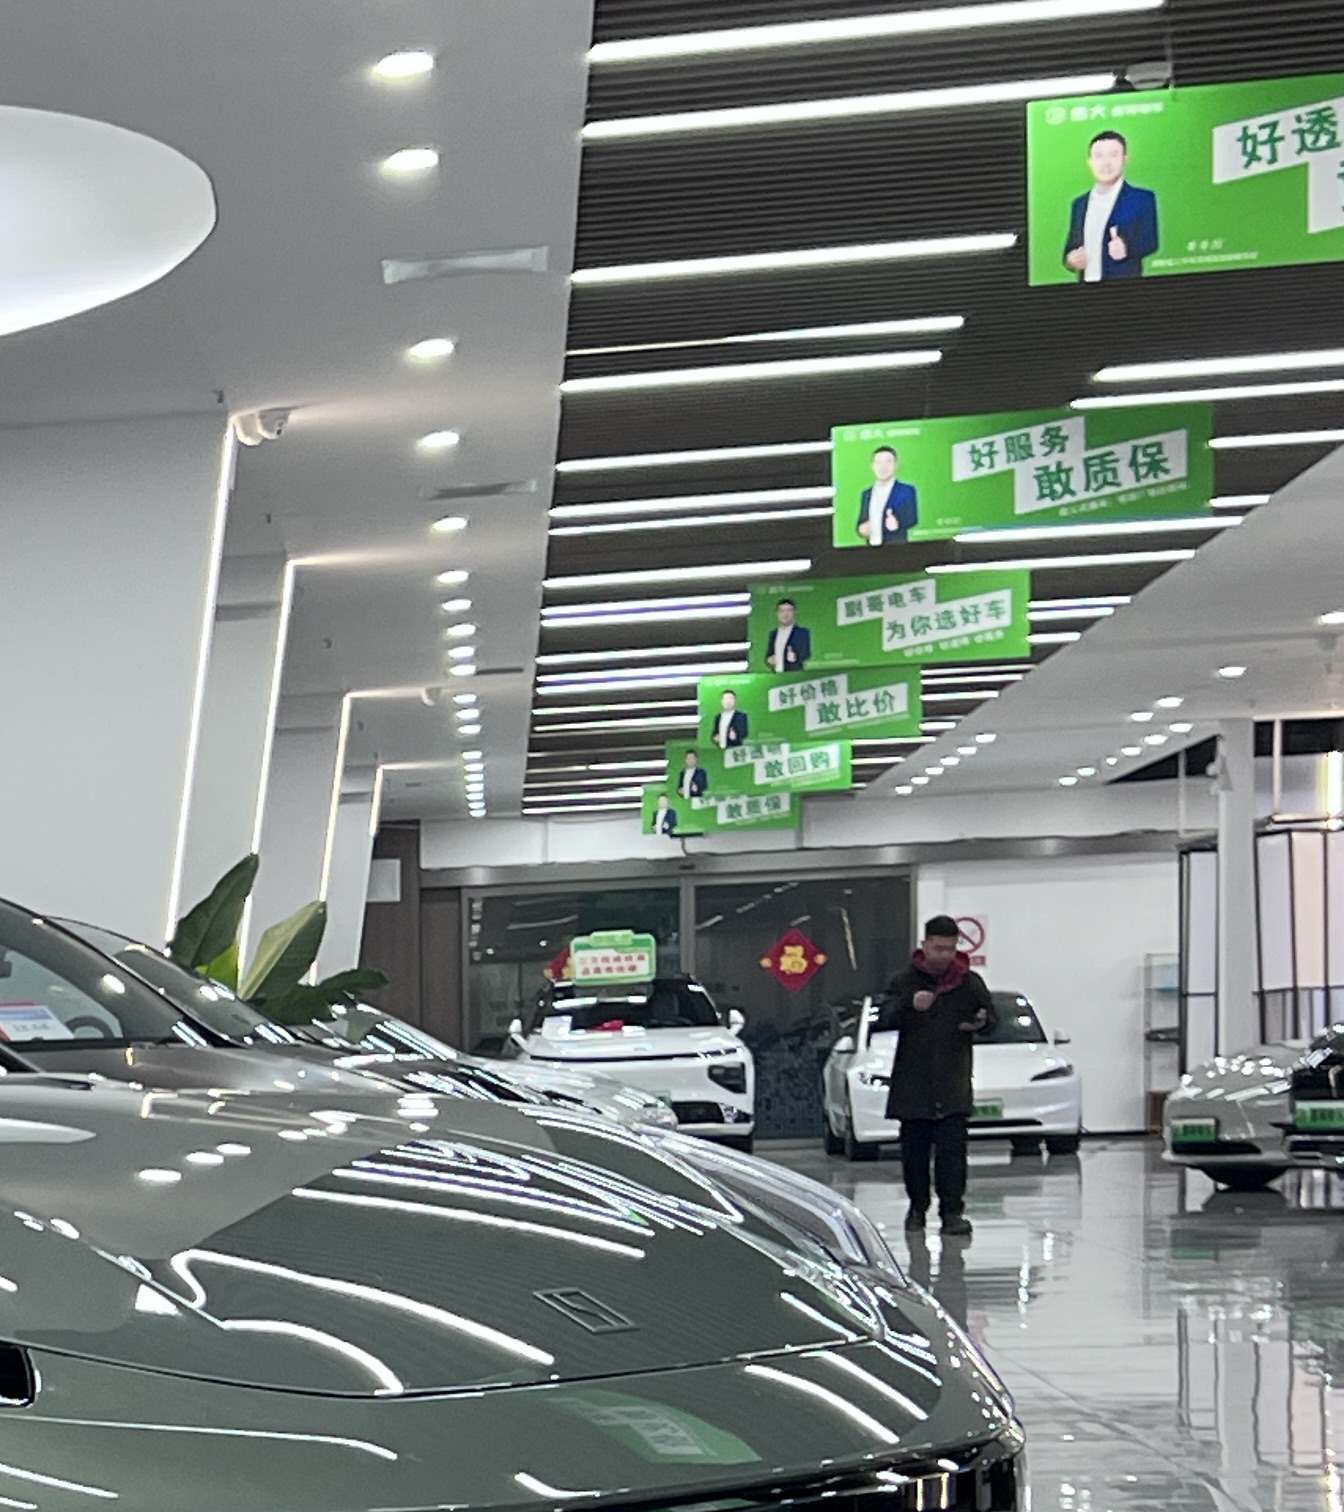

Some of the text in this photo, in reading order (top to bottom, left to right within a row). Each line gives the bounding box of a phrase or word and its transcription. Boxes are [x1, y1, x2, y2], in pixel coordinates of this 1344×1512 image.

[1236, 106, 1342, 169] 好透
[968, 425, 1069, 471] 好服务
[1033, 441, 1170, 502] 敢质保
[886, 599, 1007, 642] 为你选好车
[779, 680, 838, 705] 好价格
[817, 690, 895, 724] 敢比价
